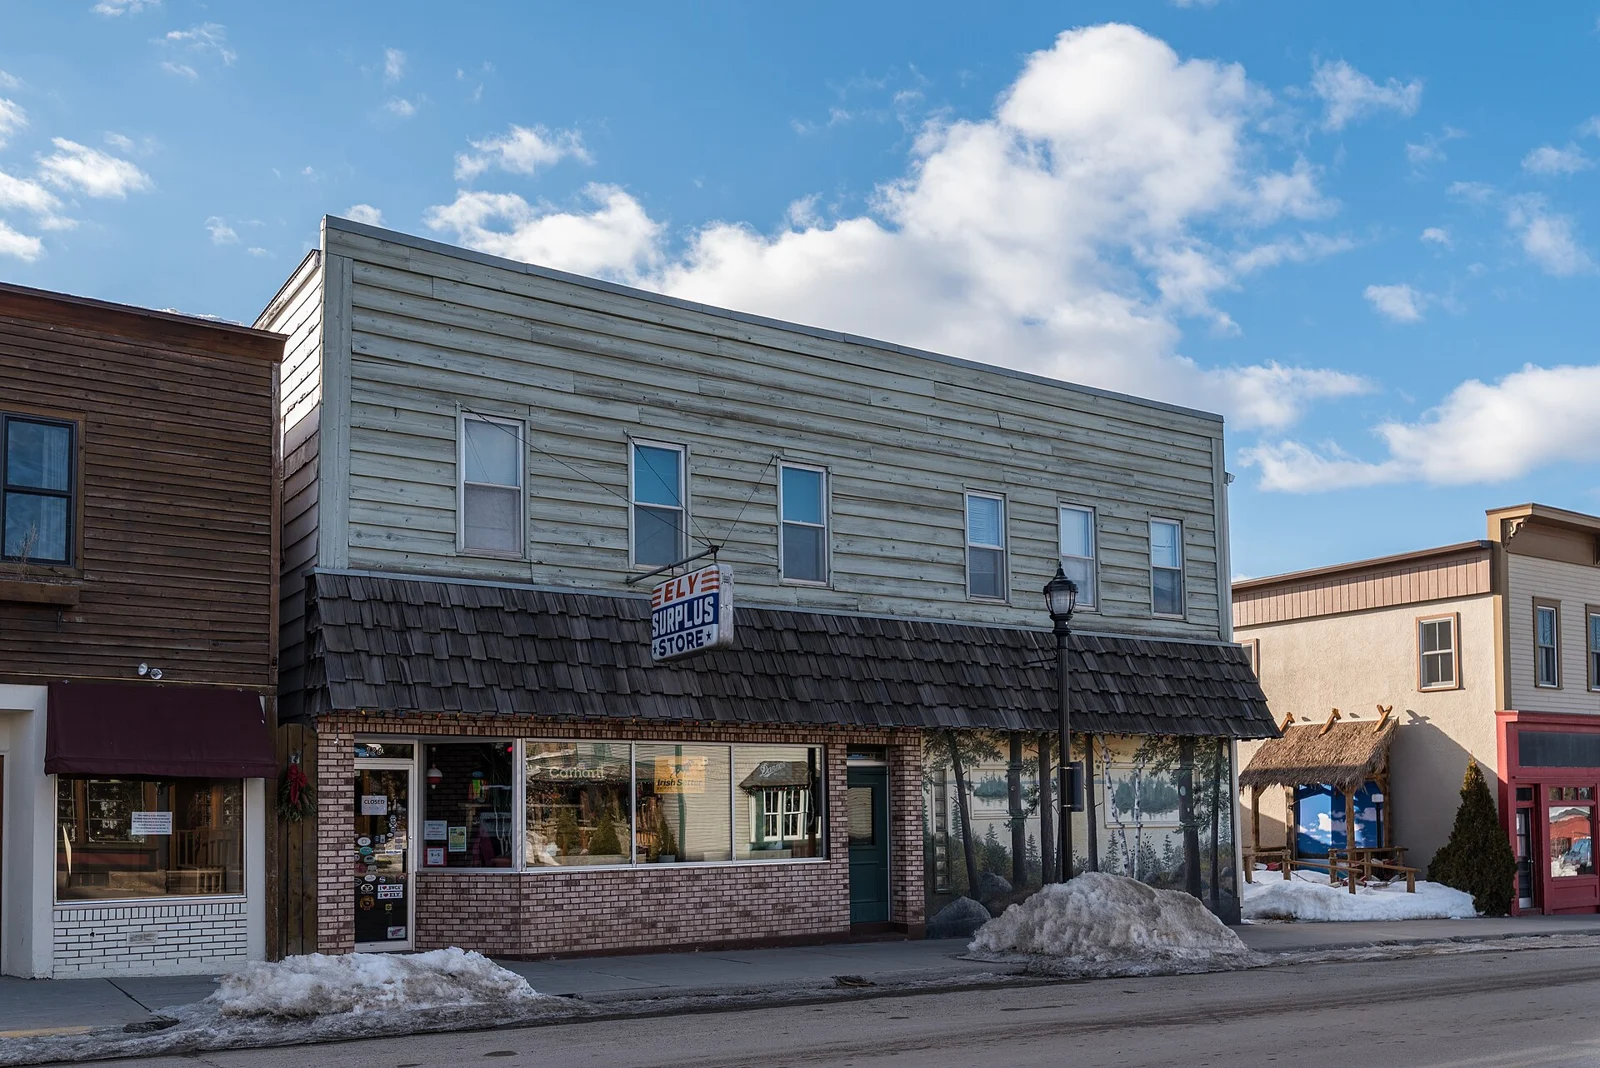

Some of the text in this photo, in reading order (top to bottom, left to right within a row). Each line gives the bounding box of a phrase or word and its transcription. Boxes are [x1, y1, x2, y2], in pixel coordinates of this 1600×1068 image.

[664, 573, 699, 602] ELY
[652, 596, 714, 637] SURPLUS
[658, 629, 704, 656] STORE
[549, 766, 605, 778] Carhartt
